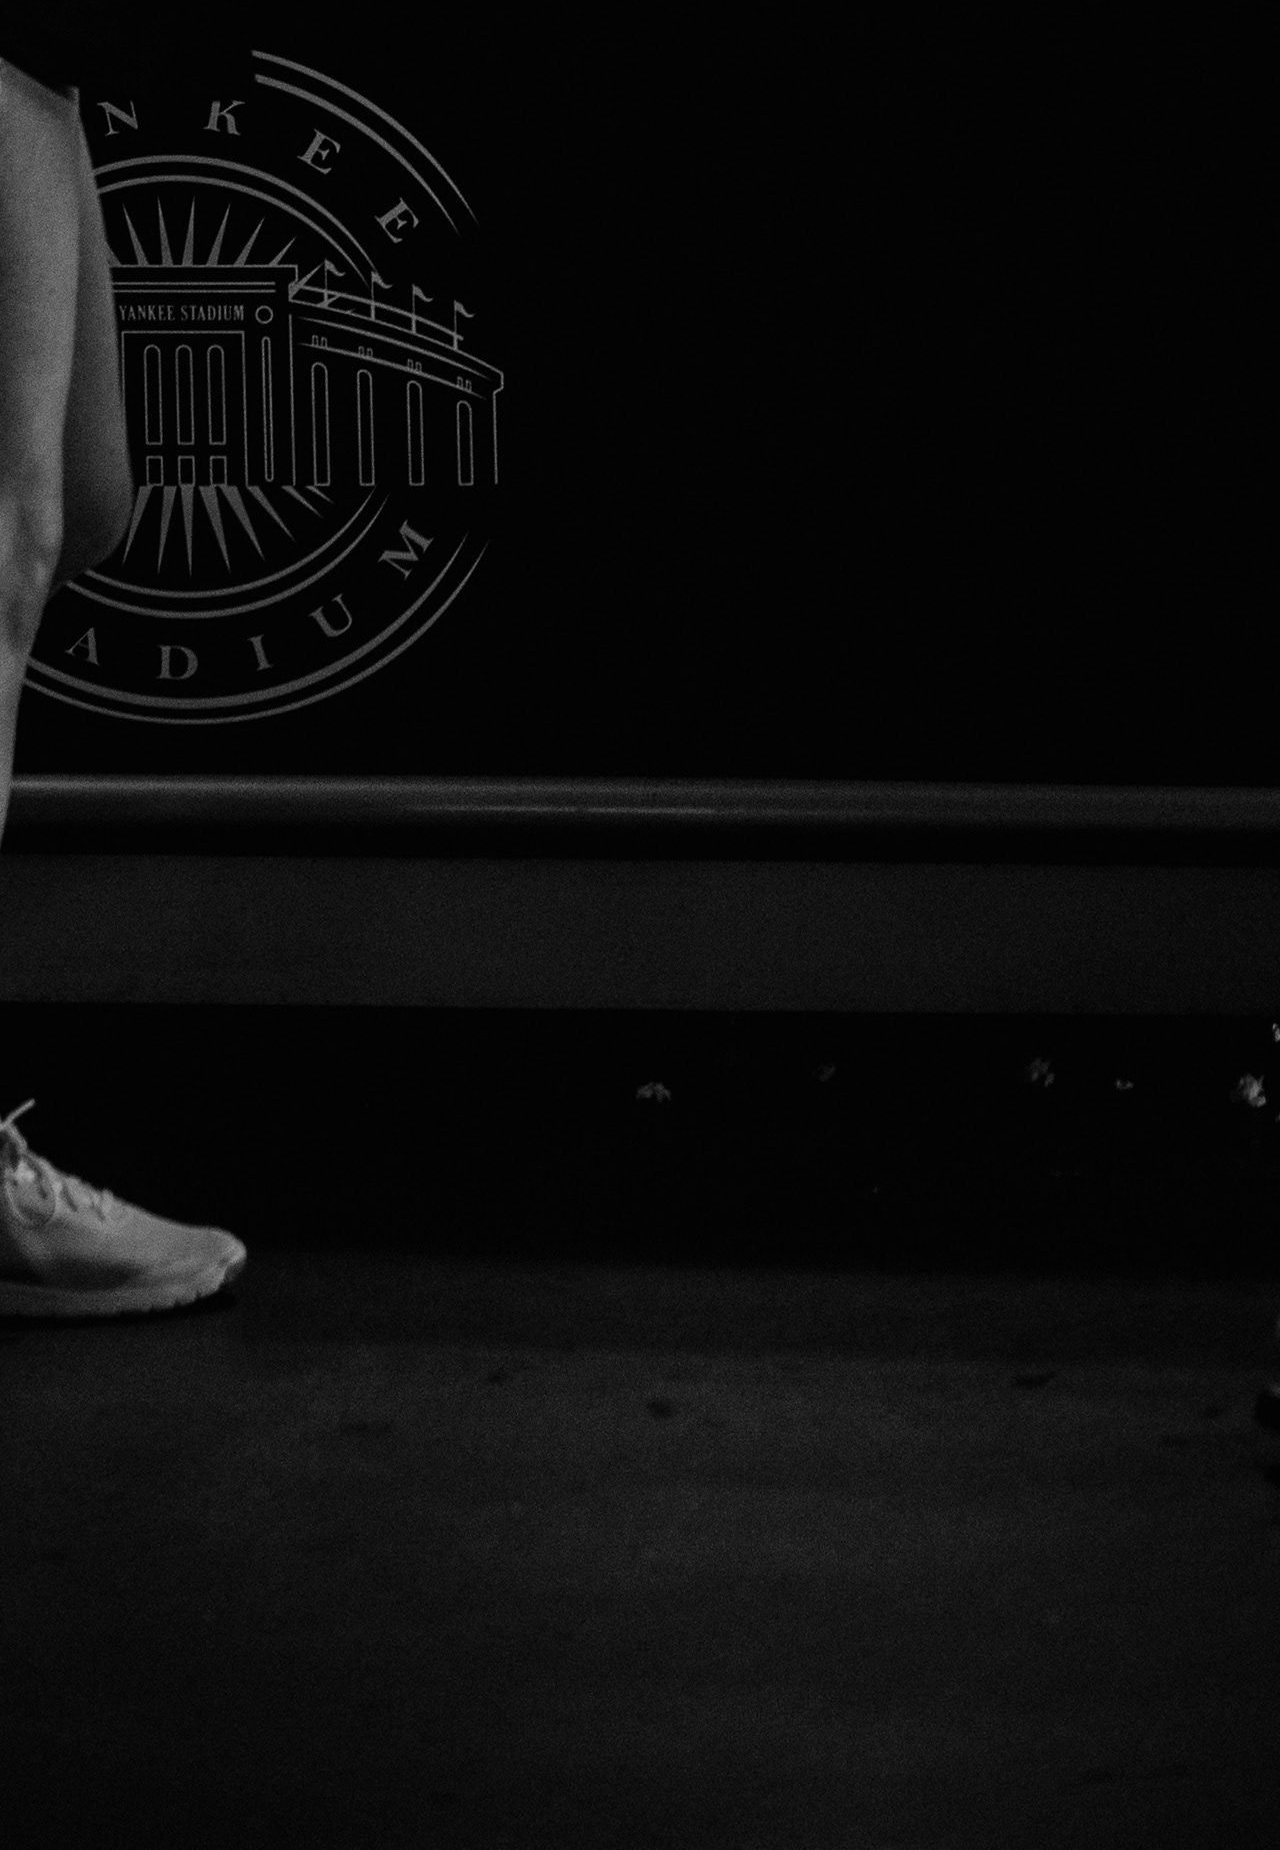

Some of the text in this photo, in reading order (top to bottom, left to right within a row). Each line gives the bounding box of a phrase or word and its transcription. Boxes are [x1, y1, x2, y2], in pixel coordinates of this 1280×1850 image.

[97, 99, 420, 244] NKEE
[119, 304, 245, 322] YANKEE STADIUM
[63, 520, 436, 683] ADIUM
